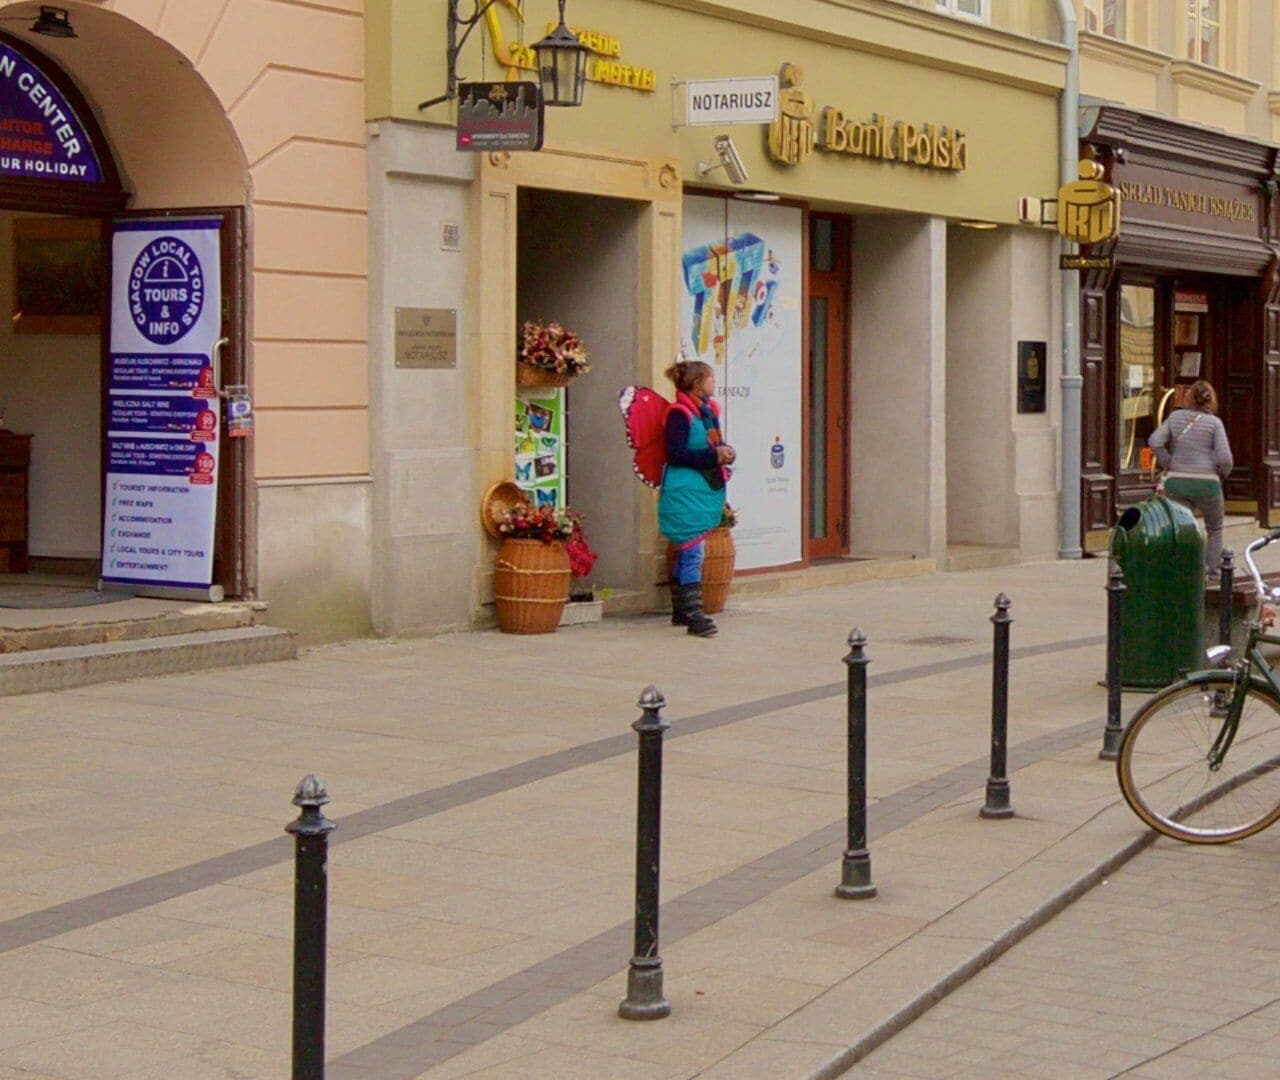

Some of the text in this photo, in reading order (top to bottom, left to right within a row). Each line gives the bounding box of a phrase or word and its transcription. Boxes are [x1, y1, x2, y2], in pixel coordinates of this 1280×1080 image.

[692, 91, 772, 111] NOTARIUSZ
[17, 72, 81, 159] CENTER
[0, 136, 53, 155] HANGE
[826, 106, 967, 171] Bank Polski
[1, 157, 87, 177] UR HOLIDAY
[1164, 187, 1206, 213] TANICH
[131, 241, 201, 326] CRACOW LOCAL TOURS
[144, 288, 187, 302] TOURS
[160, 304, 170, 318] &
[149, 322, 179, 335] INFO
